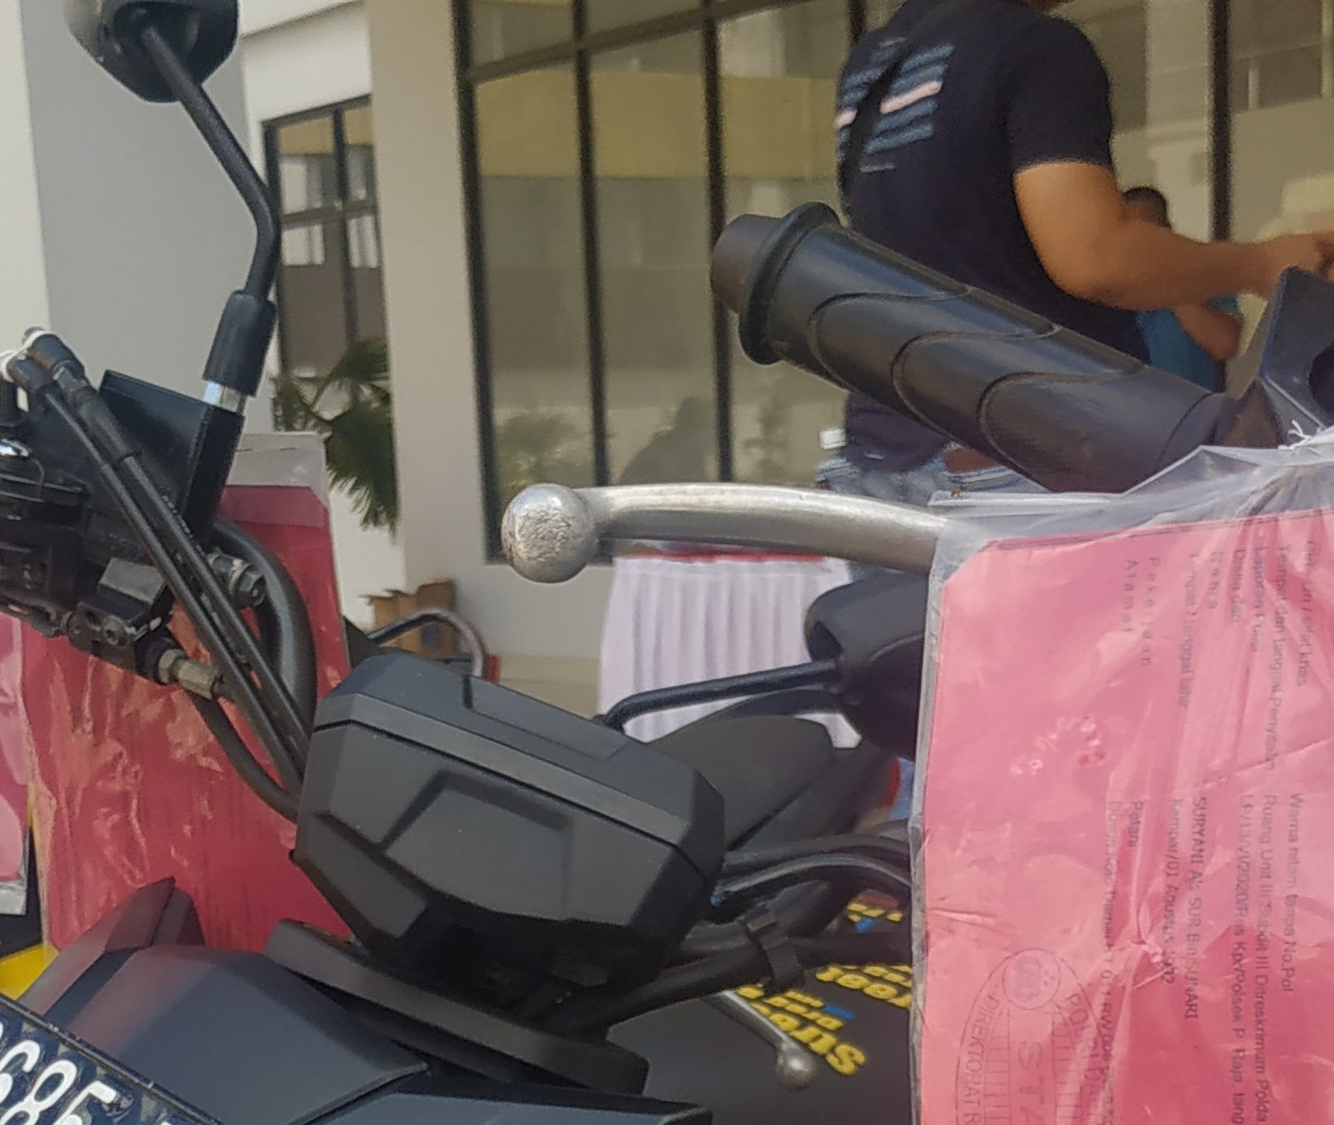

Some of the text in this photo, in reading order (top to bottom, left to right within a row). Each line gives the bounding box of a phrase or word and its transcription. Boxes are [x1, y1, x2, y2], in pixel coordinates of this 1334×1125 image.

[1125, 800, 1143, 848] Petani
[1188, 795, 1208, 865] SURYANI
[1256, 793, 1276, 845] Ruang
[1185, 896, 1203, 928] SUR
[1253, 975, 1271, 1075] Ditreskrimum
[1254, 1079, 1271, 1123] Polda
